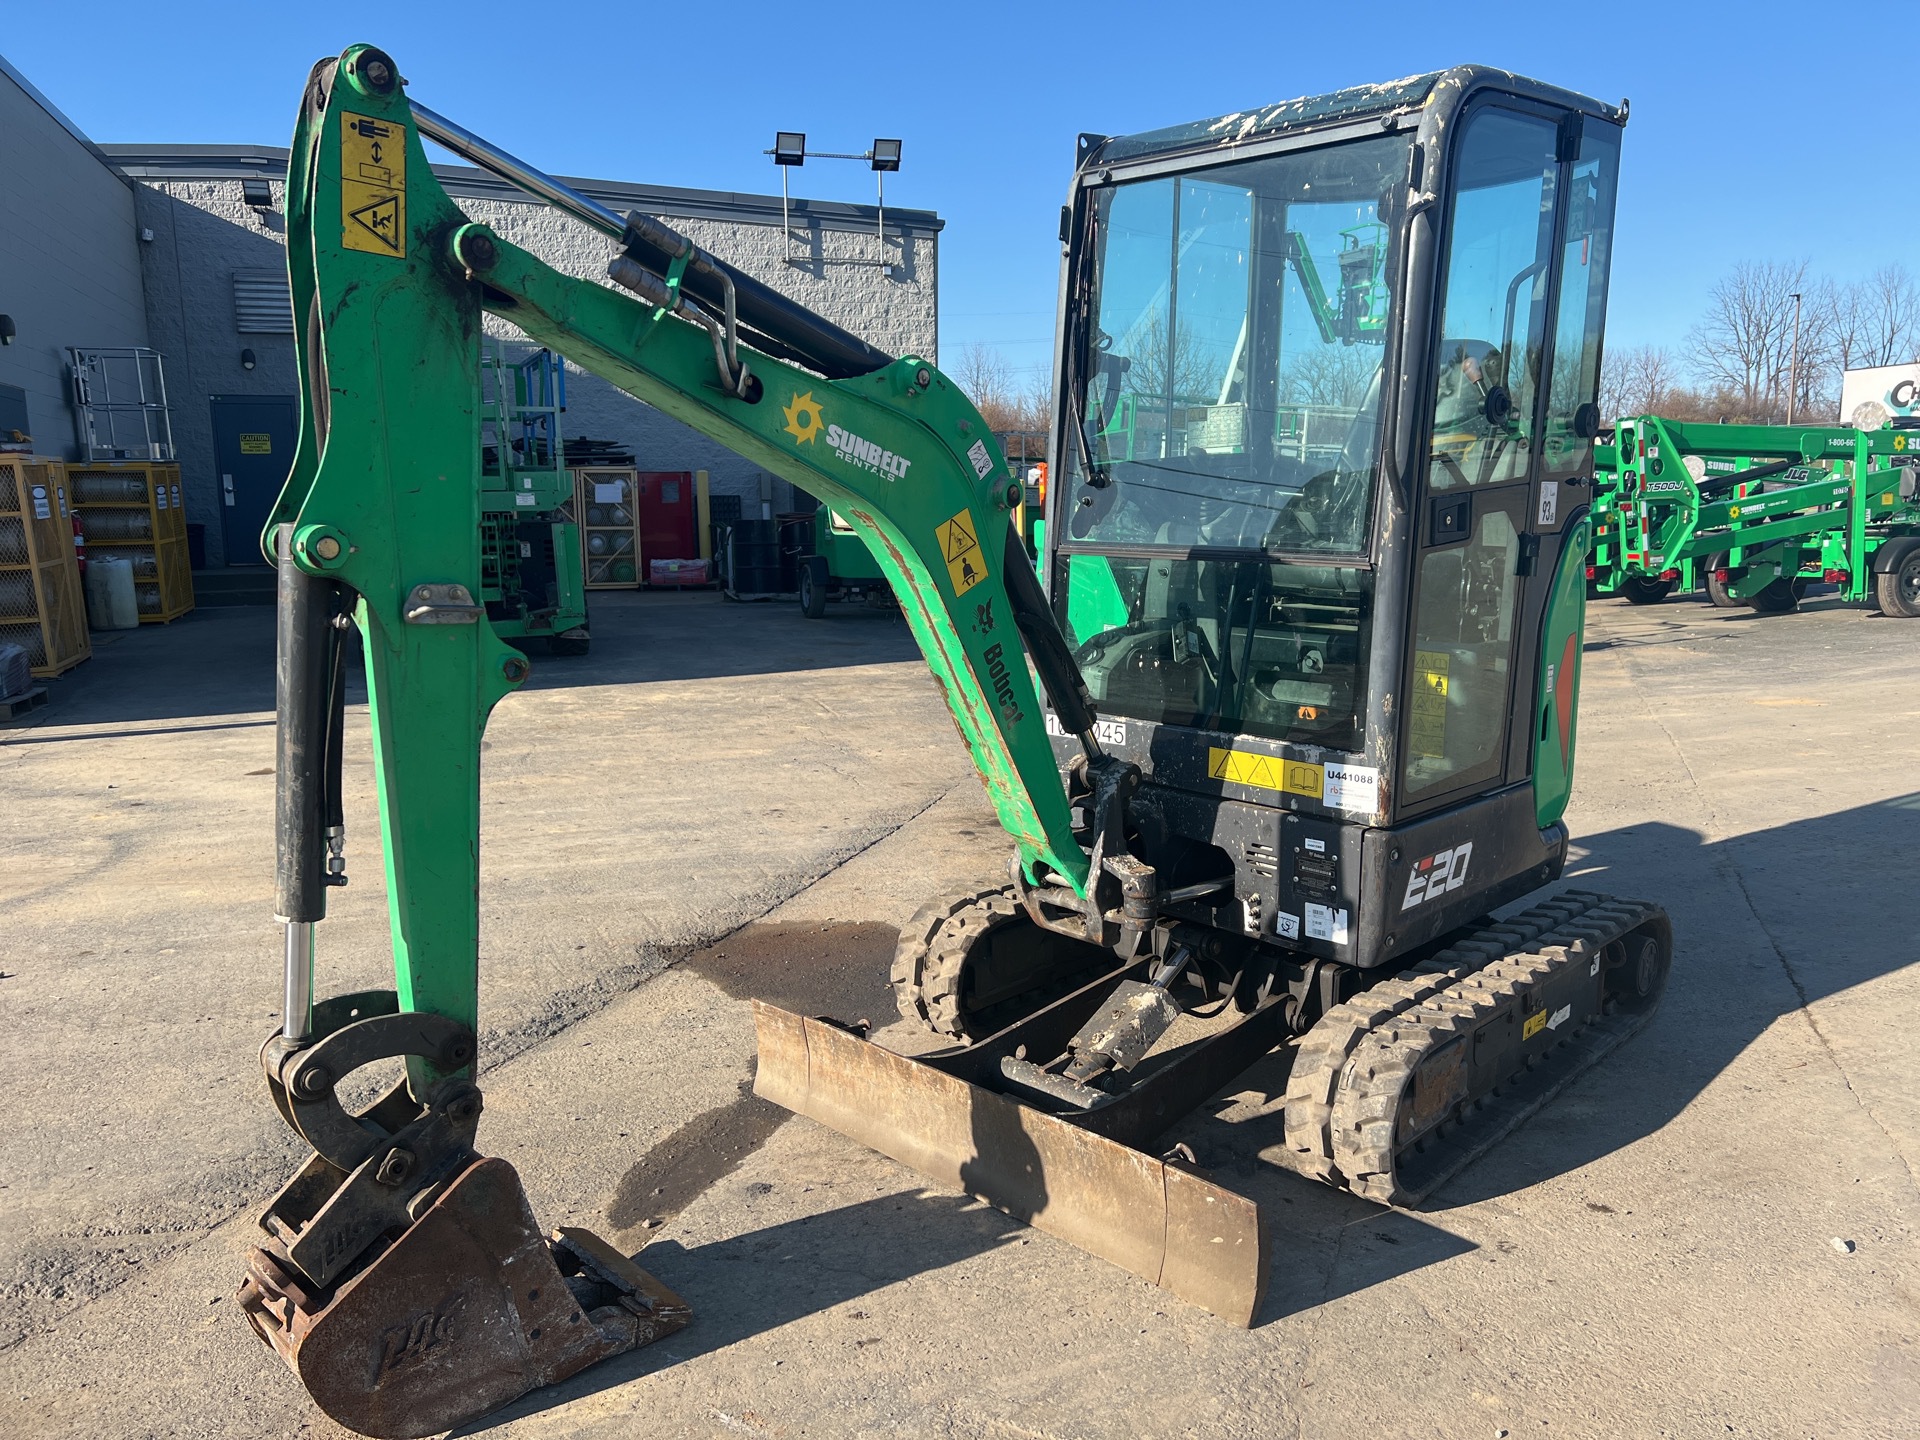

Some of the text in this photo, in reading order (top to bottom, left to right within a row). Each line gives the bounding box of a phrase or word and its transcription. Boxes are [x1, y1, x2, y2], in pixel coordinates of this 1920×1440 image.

[1828, 438, 1874, 447] 1-800-66728
[825, 423, 911, 479] SUNBELT
[835, 449, 896, 483] RENTALS
[1706, 460, 1736, 472] SUNBE
[1782, 466, 1810, 482] JLG
[1647, 481, 1684, 493] T500J
[1740, 503, 1766, 514] SUNBELT
[983, 642, 1024, 731] Bobcat
[1327, 770, 1373, 784] U441088
[1401, 841, 1473, 911] E20
